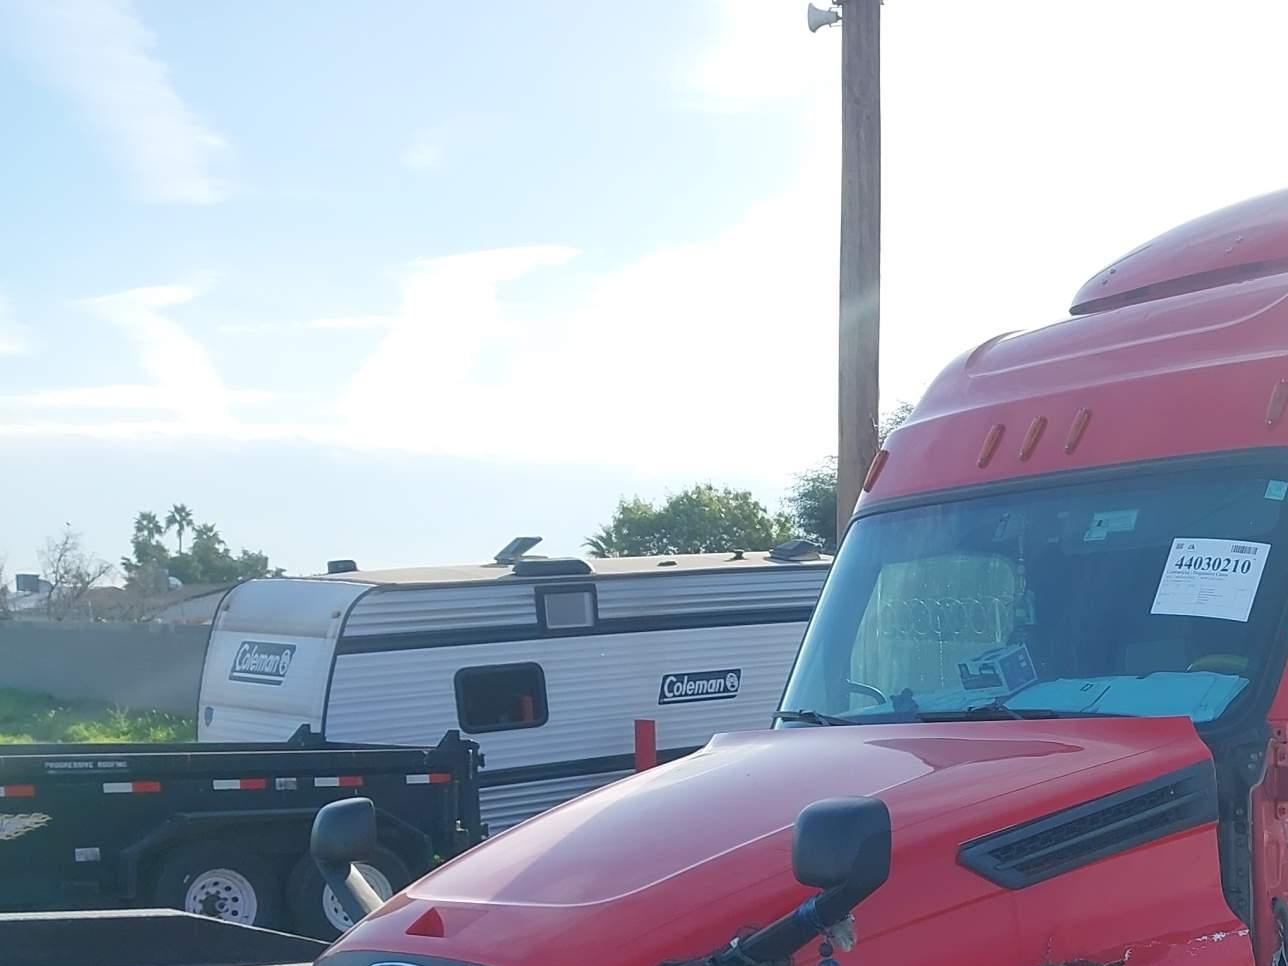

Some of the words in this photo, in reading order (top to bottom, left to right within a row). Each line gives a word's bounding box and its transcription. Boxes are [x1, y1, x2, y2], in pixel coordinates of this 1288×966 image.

[1174, 556, 1252, 575] 44030210
[235, 643, 281, 673] Coleman
[664, 675, 725, 698] Coleman
